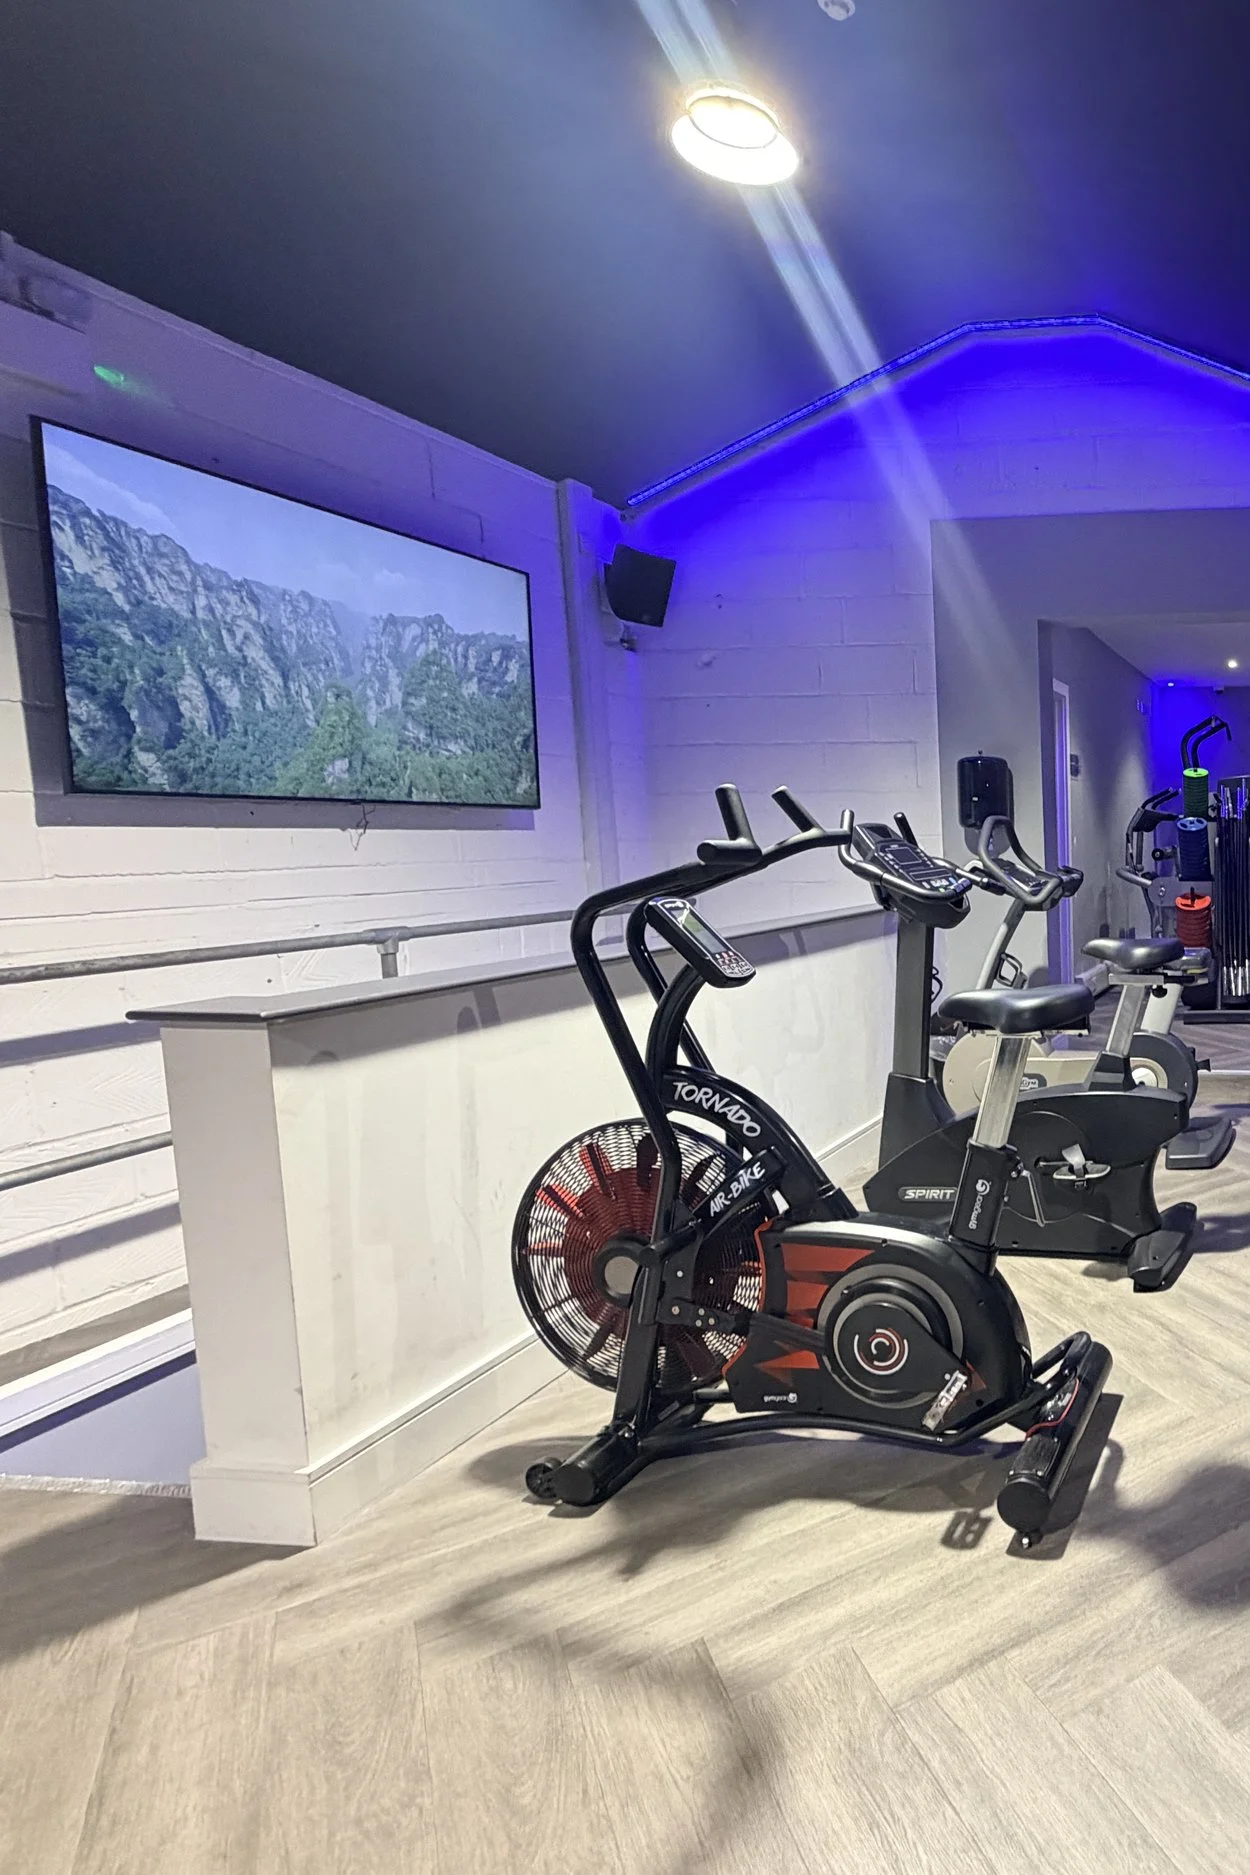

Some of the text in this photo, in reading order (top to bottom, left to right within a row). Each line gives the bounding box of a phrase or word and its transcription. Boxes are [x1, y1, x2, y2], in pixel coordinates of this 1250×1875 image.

[672, 1081, 761, 1137] TORNADO
[709, 1161, 766, 1217] AIR-BIKE
[904, 1189, 956, 1200] SPIRIT
